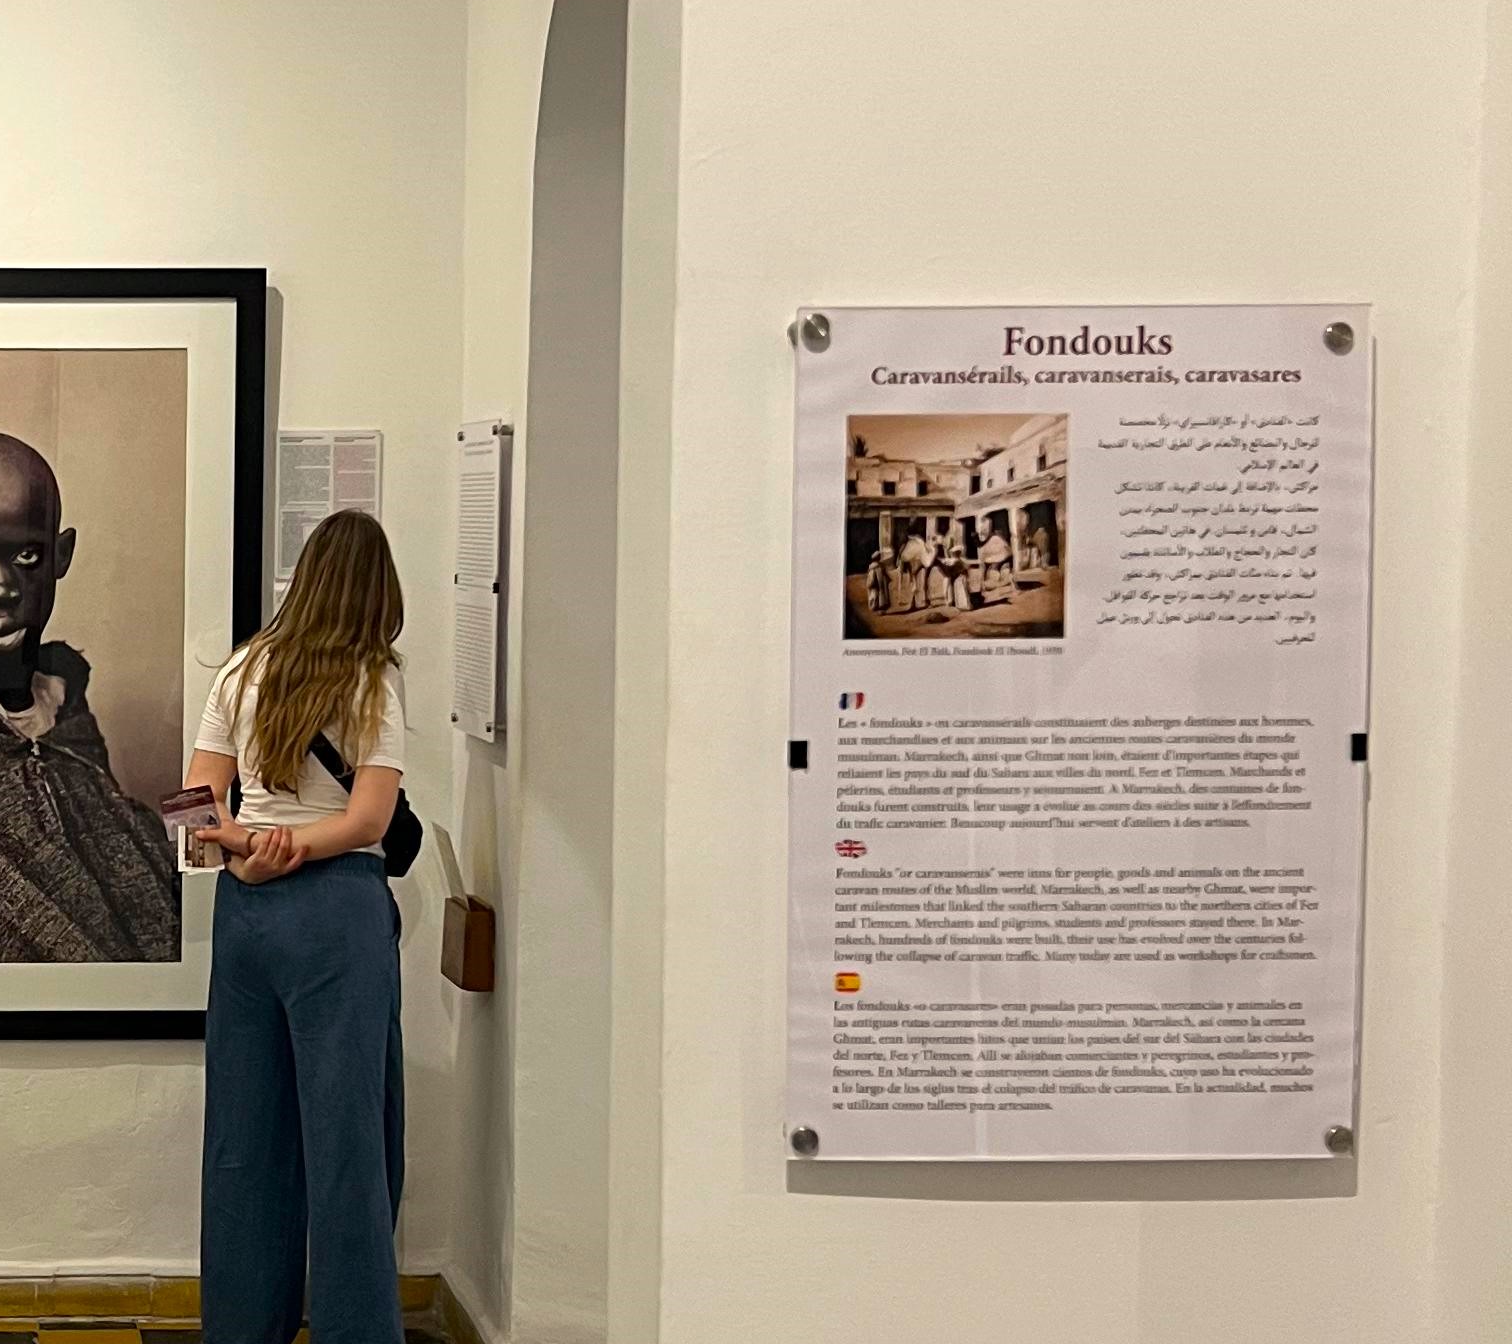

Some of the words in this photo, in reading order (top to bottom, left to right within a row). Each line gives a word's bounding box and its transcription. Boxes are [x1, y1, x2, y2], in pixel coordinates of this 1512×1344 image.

[1001, 325, 1174, 357] Fondouks
[870, 365, 1030, 387] Caravansérails,
[1034, 365, 1180, 386] caravanserais,
[1184, 369, 1302, 384] caravasares
